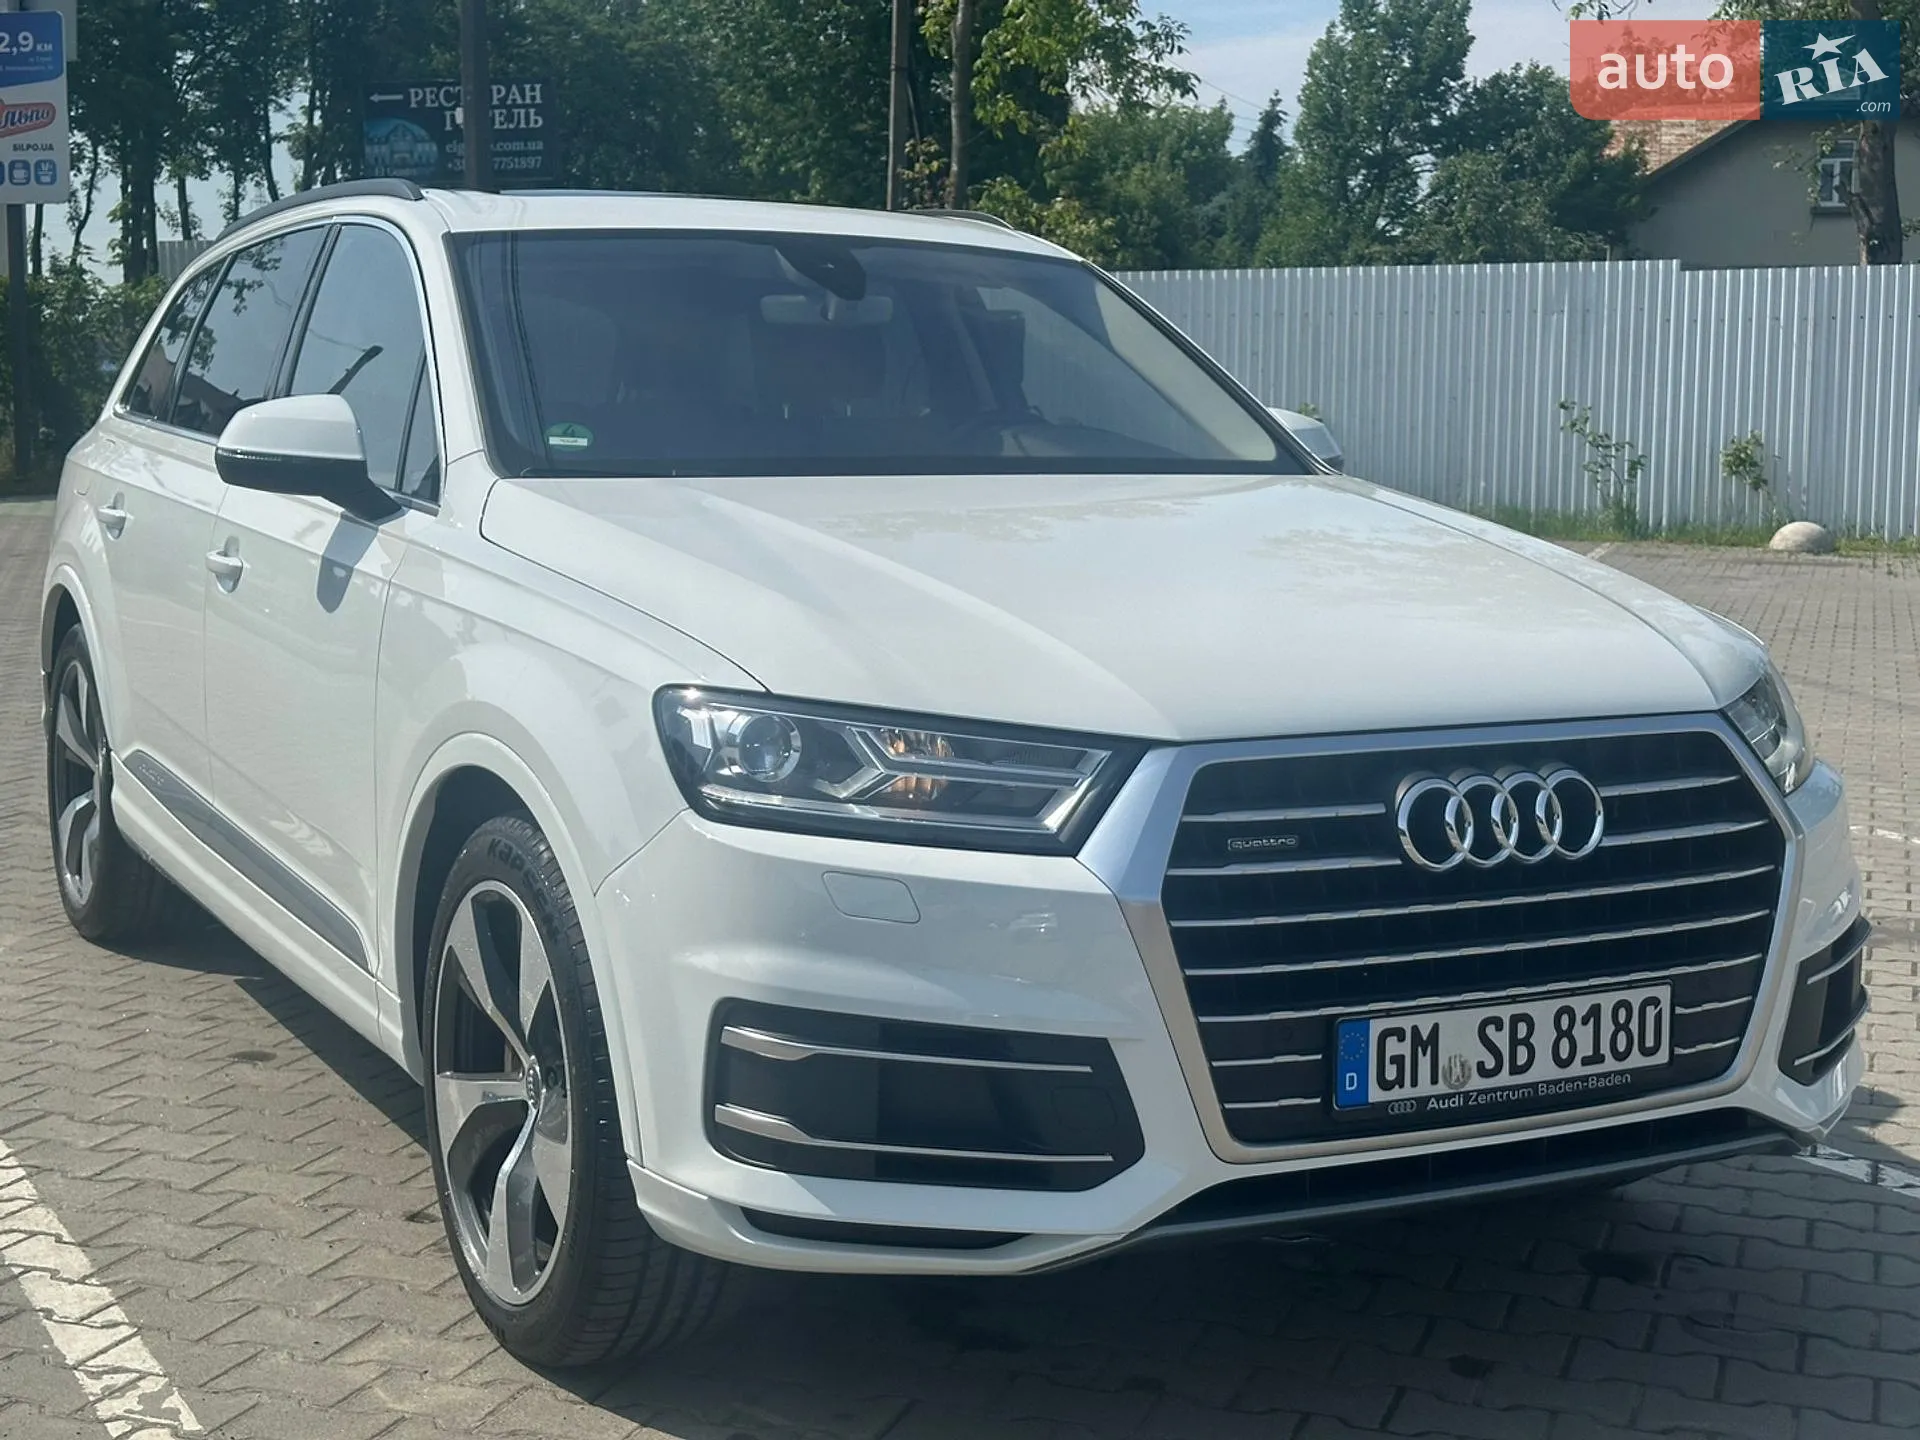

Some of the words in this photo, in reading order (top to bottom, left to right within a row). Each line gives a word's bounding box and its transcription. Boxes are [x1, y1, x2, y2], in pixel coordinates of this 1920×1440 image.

[408, 83, 543, 108] РЕСТРАН
[1230, 837, 1297, 849] quattro
[1376, 1022, 1440, 1092] GM
[1476, 1012, 1536, 1079] SB
[1551, 995, 1663, 1070] 8180
[1345, 1073, 1357, 1091] D
[1426, 1094, 1464, 1111] Audi
[1468, 1086, 1534, 1106] Zentrum
[1537, 1072, 1632, 1096] Baden-Baden
